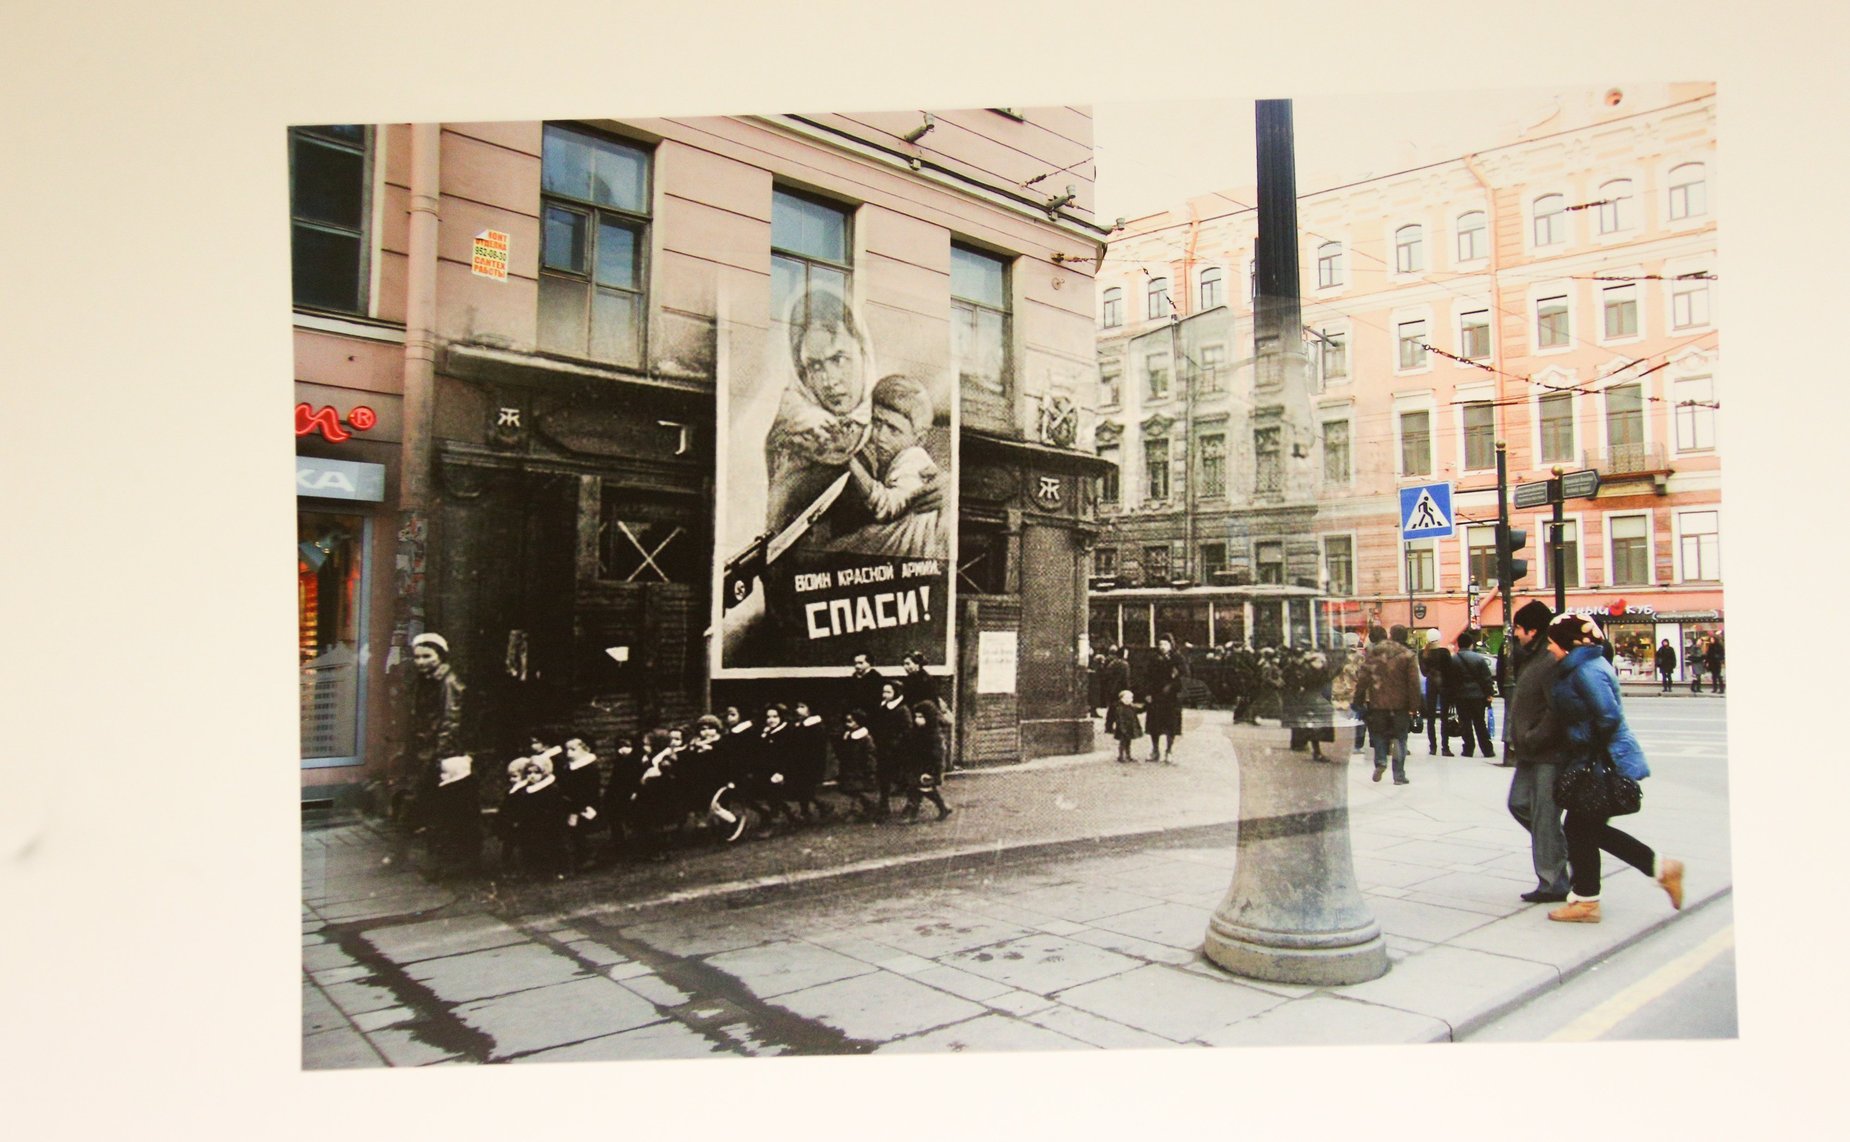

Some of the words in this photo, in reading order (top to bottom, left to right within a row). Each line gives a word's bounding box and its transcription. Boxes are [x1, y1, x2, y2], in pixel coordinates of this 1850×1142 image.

[795, 572, 832, 592] ВОИН
[837, 562, 895, 587] КРАСНОЙ
[805, 586, 931, 640] СПАСИ!
